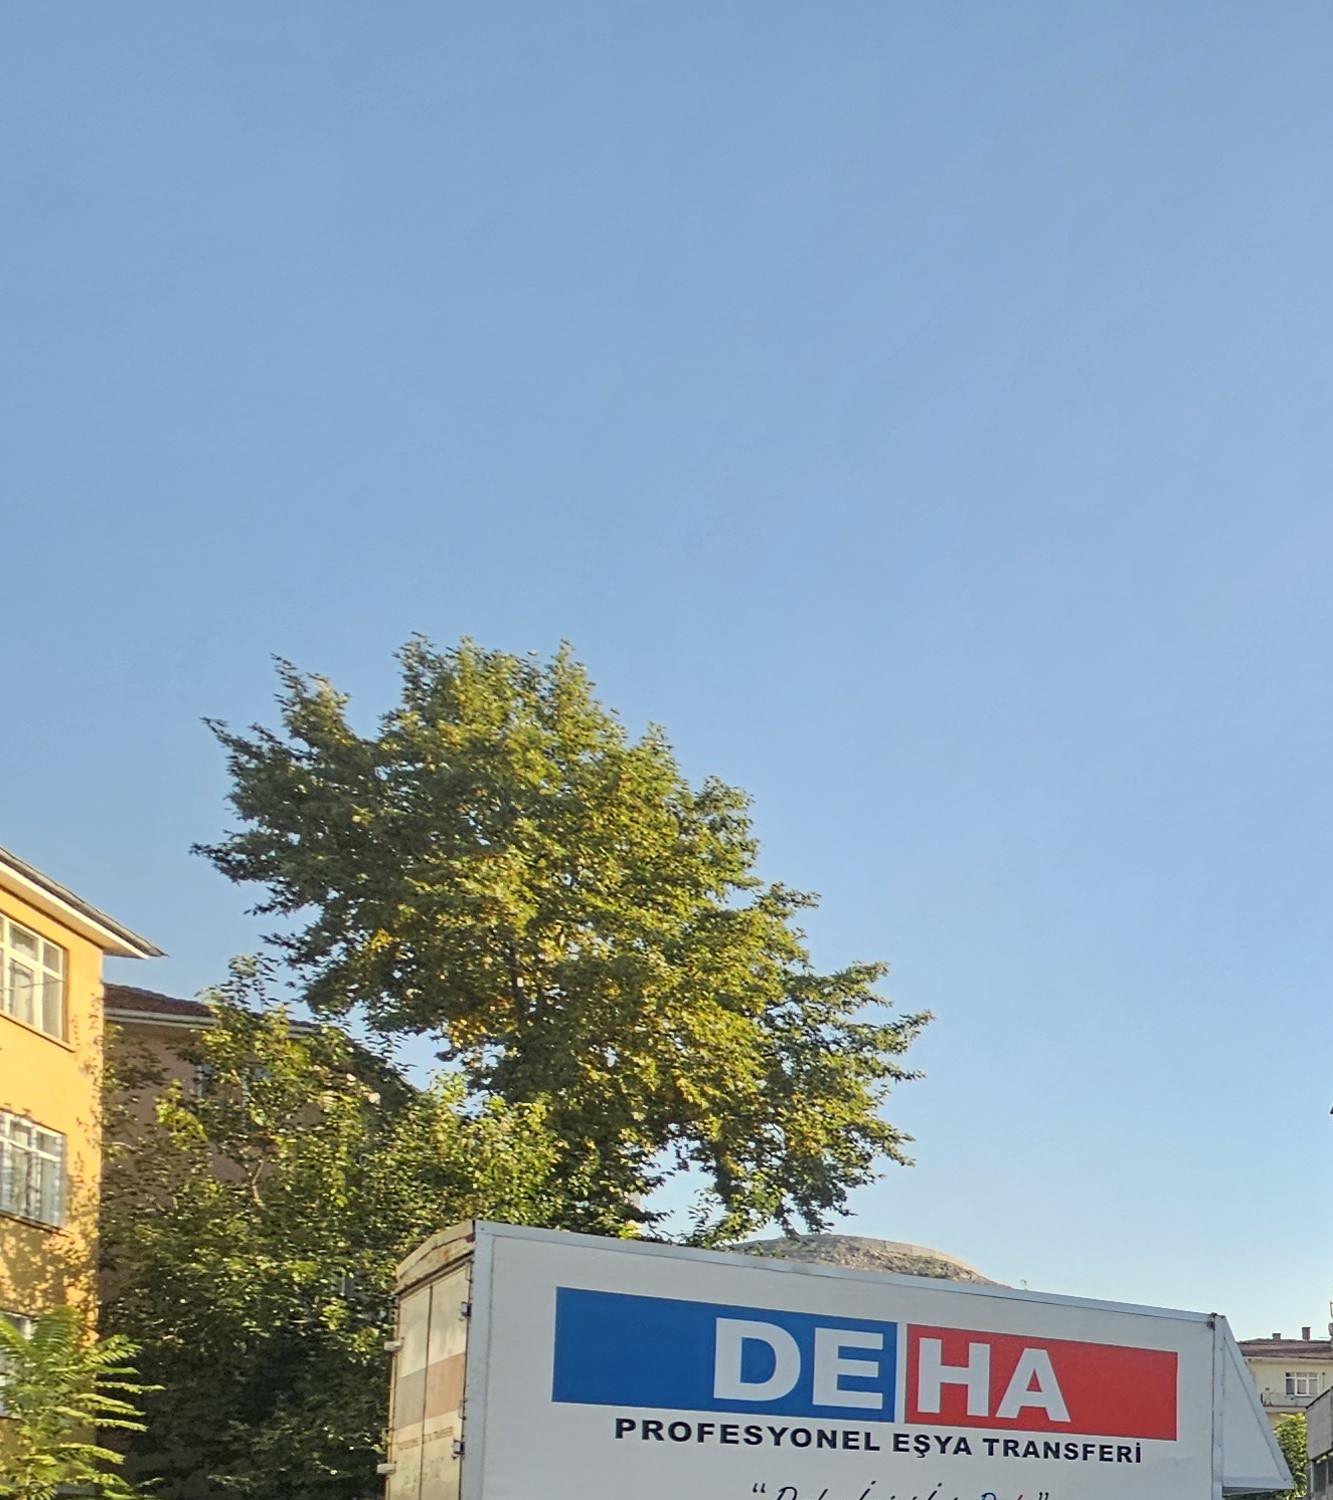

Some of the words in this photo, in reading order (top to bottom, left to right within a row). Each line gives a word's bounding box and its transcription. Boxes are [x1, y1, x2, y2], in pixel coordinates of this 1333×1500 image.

[713, 1317, 1071, 1423] DEHA
[614, 1418, 881, 1452] PROFESYONEL
[892, 1433, 972, 1459] EŞYA
[982, 1438, 1142, 1464] TRANSFERİ
